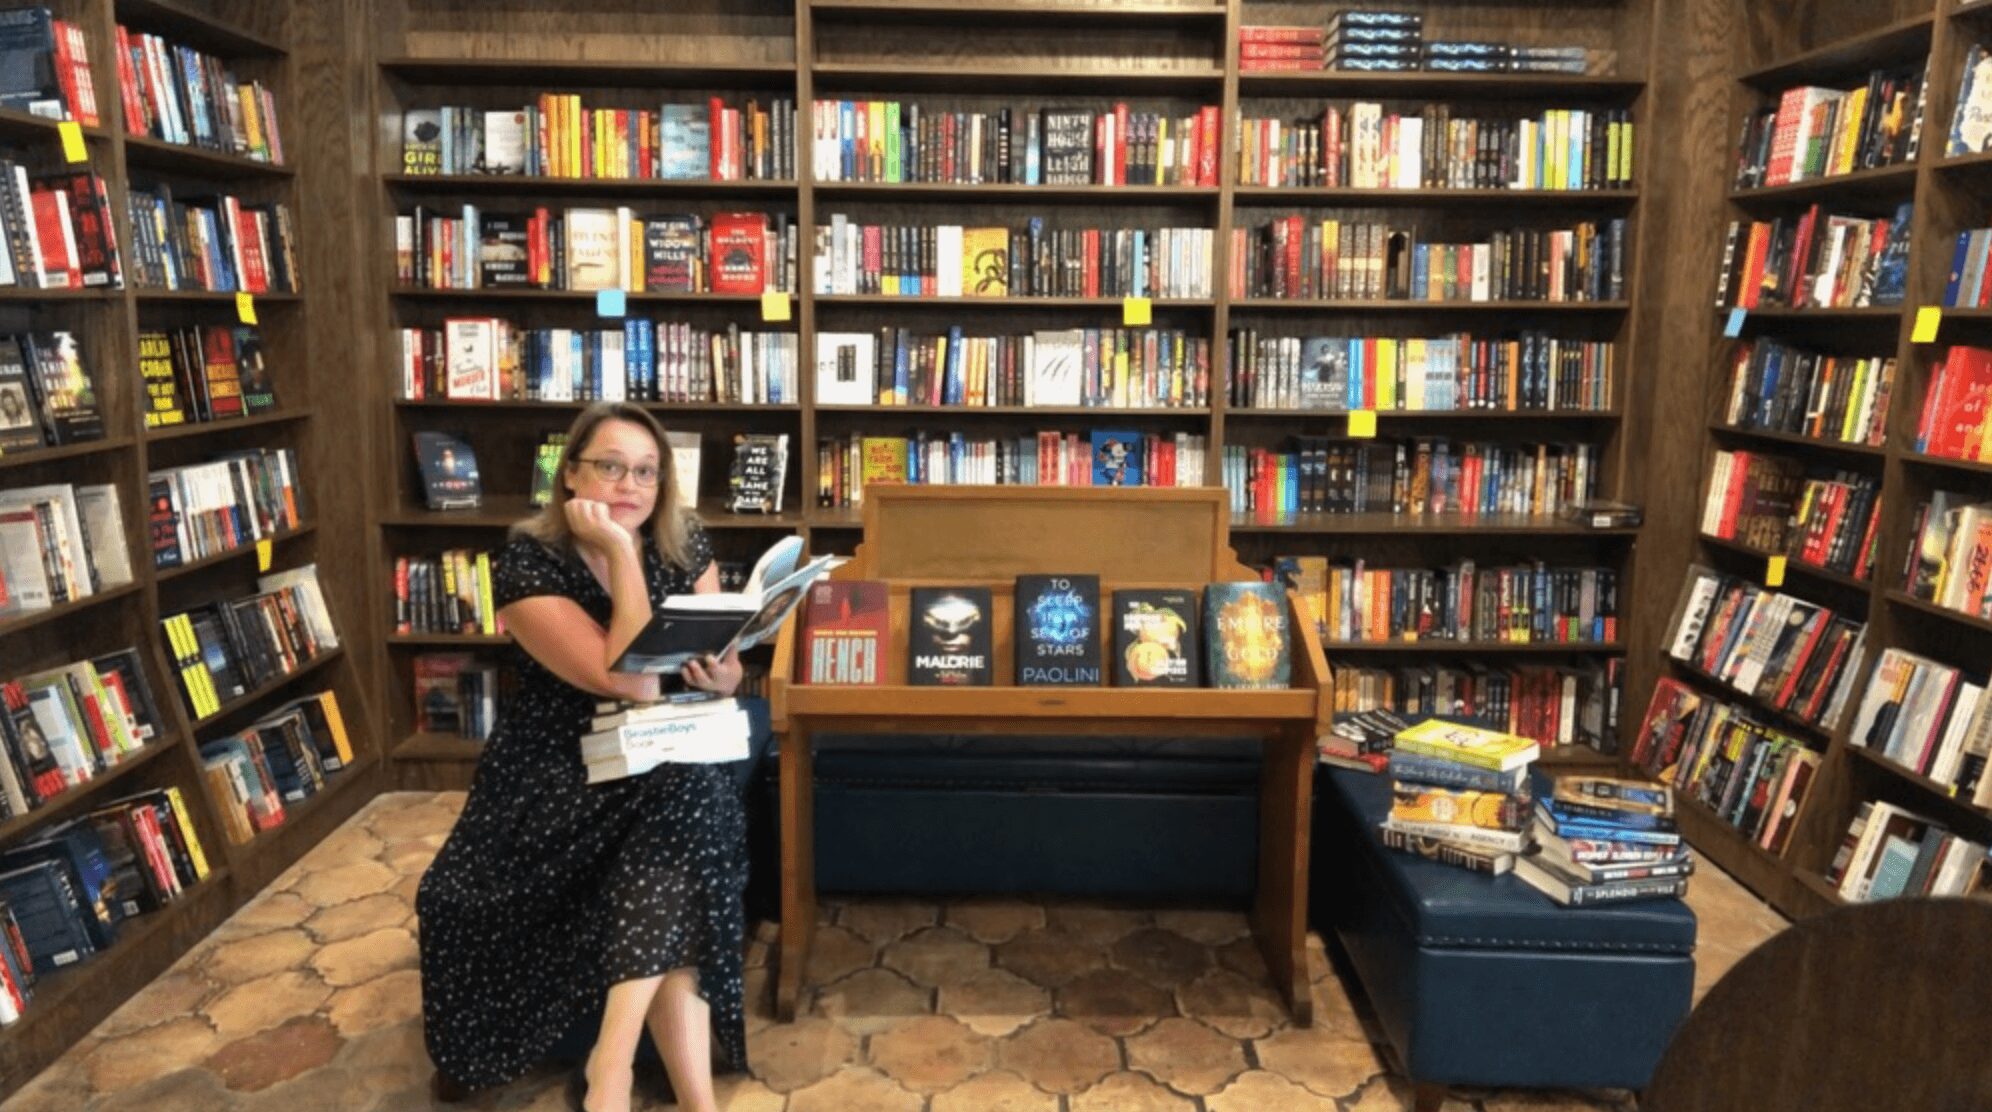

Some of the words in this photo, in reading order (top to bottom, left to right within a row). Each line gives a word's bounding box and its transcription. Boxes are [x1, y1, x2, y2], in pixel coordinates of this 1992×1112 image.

[404, 152, 440, 164] GIR
[745, 466, 766, 474] ALL
[1050, 578, 1071, 590] TO
[1037, 644, 1084, 656] STARS
[915, 655, 985, 669] MALORIE
[1023, 667, 1099, 682] PAOLINI
